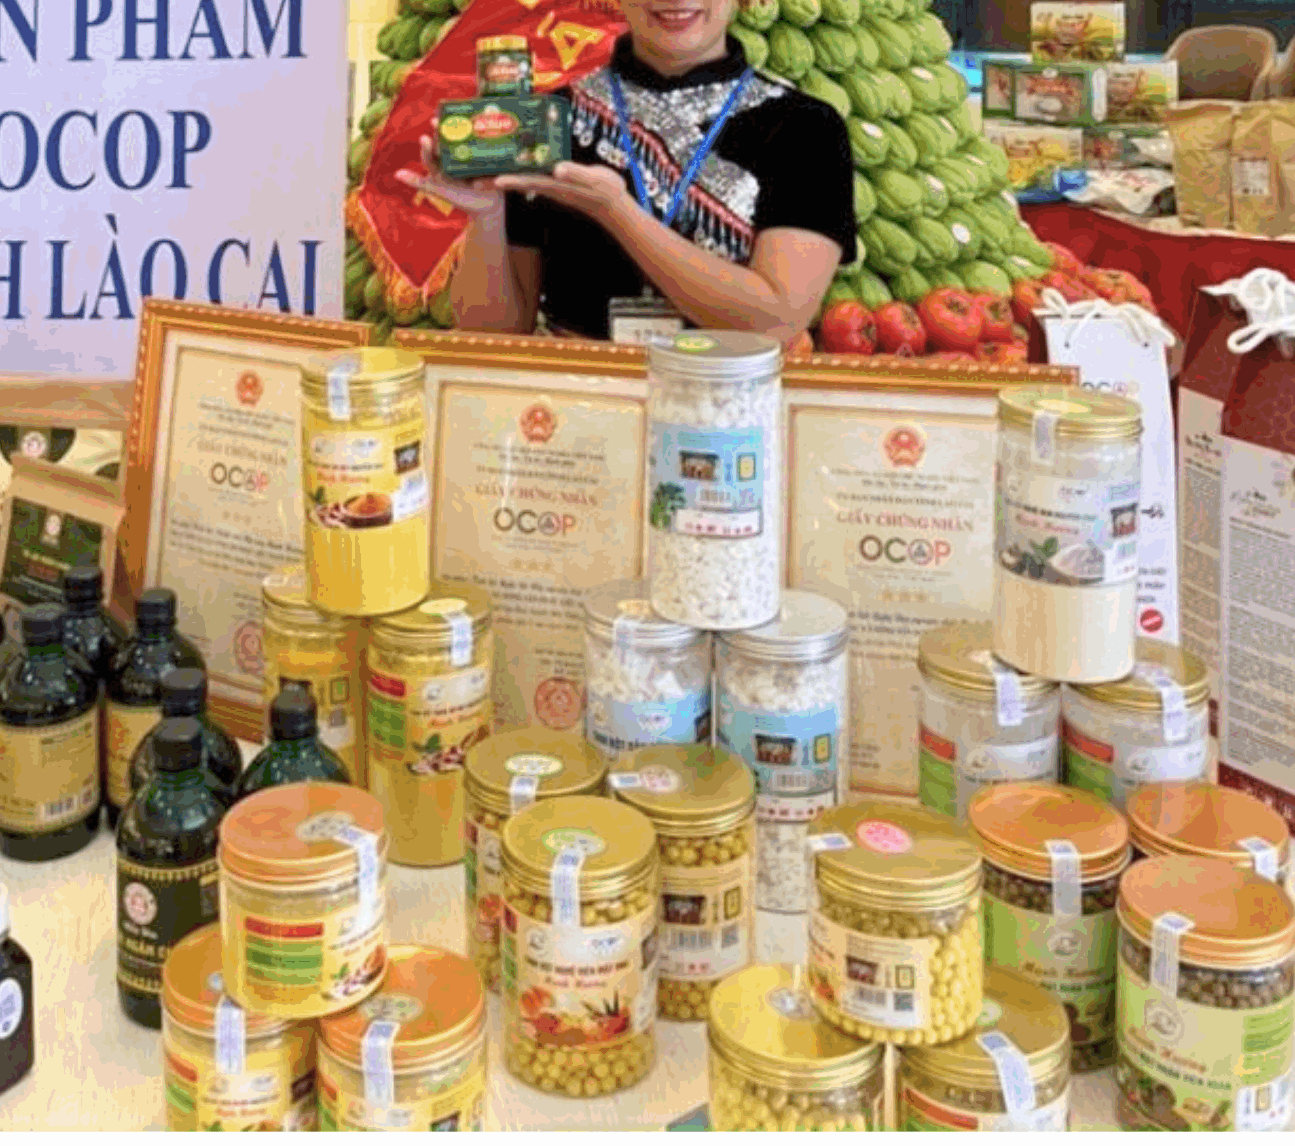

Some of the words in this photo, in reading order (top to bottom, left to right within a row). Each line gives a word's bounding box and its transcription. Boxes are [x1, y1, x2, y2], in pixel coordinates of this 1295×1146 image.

[45, 214, 189, 321] LÀO
[208, 238, 323, 316] CAI
[493, 507, 576, 536] OCOP
[859, 534, 951, 566] OCOP
